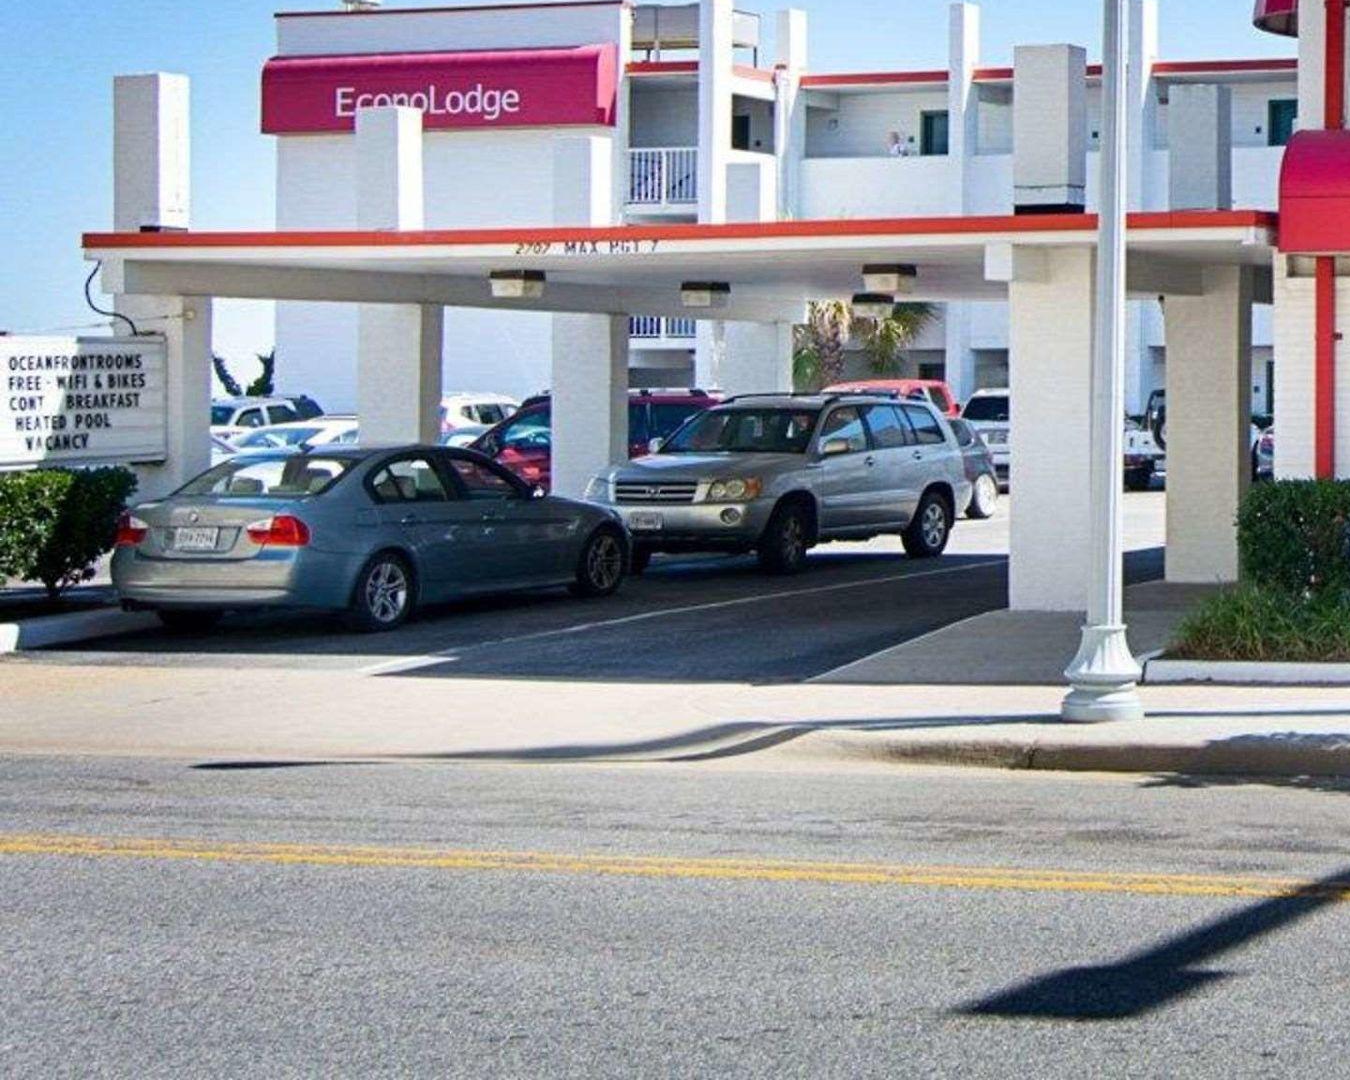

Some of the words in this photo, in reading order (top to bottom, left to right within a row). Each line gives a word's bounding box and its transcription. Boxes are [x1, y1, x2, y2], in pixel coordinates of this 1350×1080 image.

[335, 84, 520, 120] EconoLodge
[564, 240, 599, 254] MAX
[8, 376, 42, 391] FREE
[57, 374, 87, 389] WIFI
[108, 373, 146, 389] BIKES
[66, 393, 141, 410] BREAKFAST
[15, 415, 67, 431] HEATED
[75, 413, 111, 429] POOL
[25, 433, 89, 451] VACANCY
